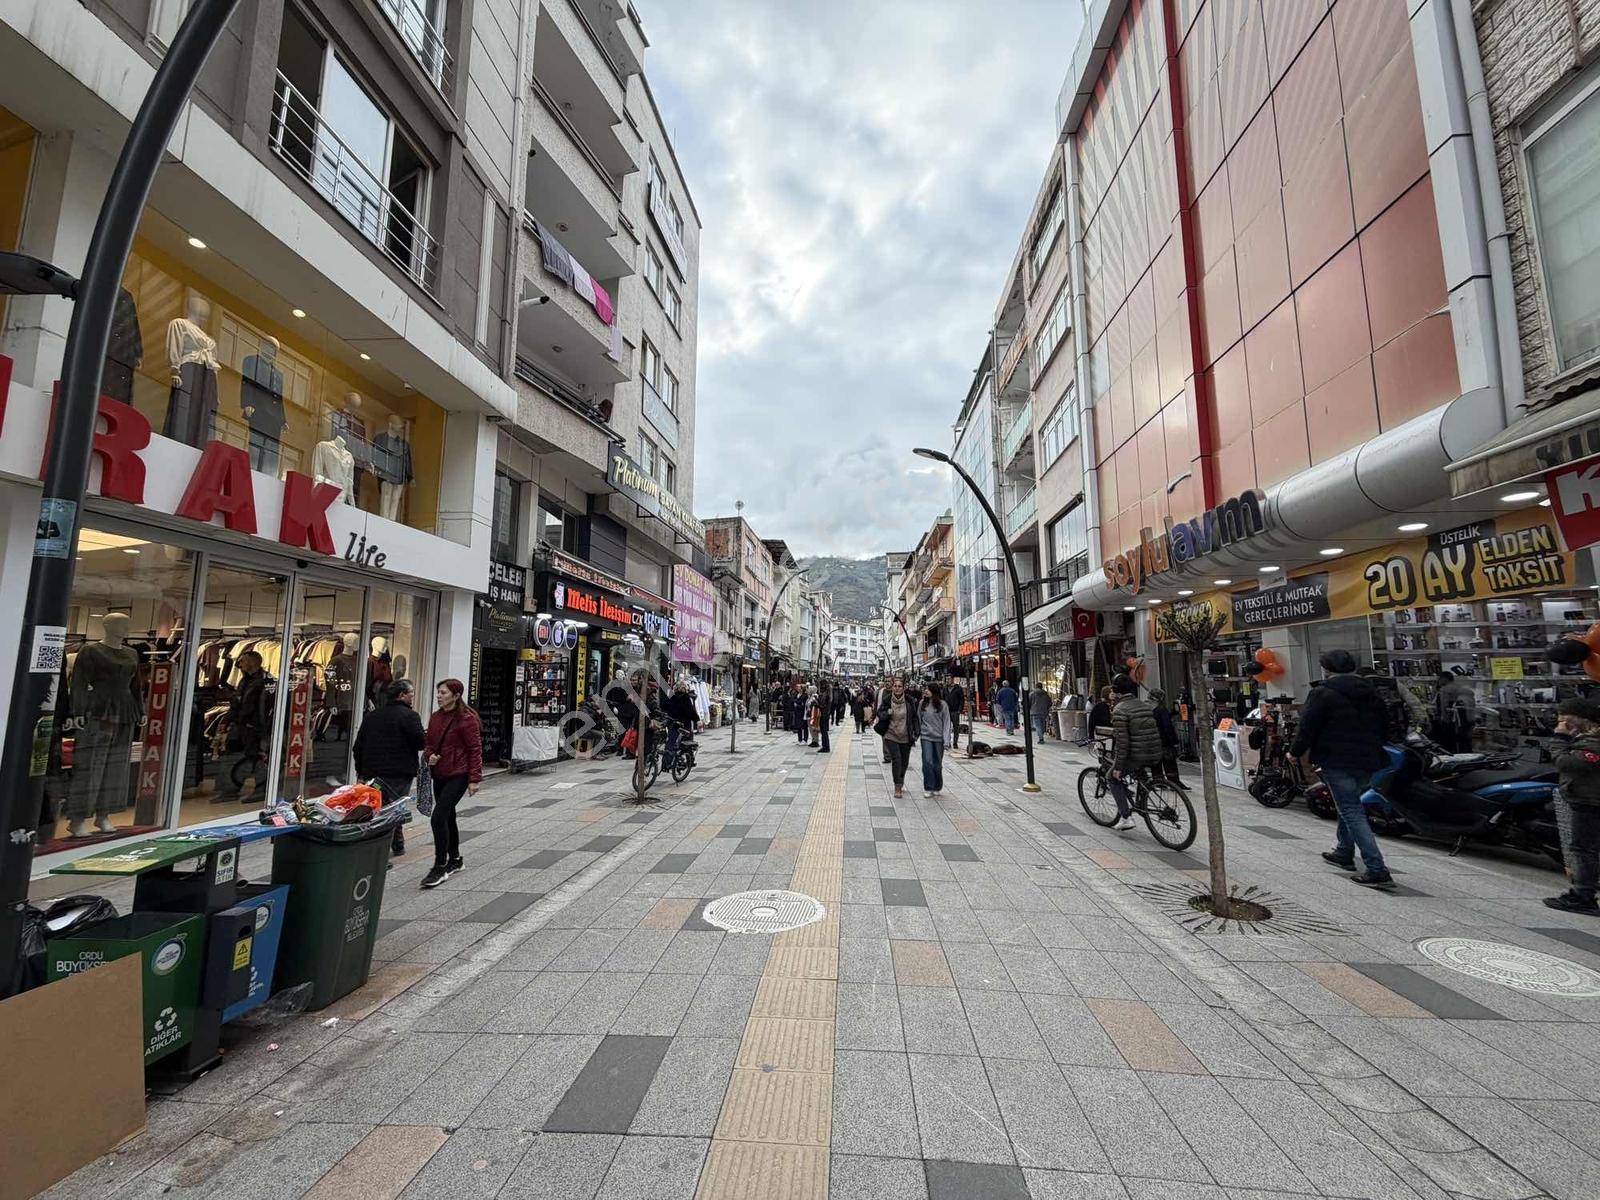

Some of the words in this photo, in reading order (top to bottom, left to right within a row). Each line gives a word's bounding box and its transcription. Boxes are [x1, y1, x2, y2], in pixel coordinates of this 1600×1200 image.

[613, 456, 658, 498] Platinum
[344, 532, 387, 569] life
[1103, 527, 1170, 596] soylu
[1171, 489, 1266, 564] avm
[1440, 525, 1481, 546] ÜSTELİK
[1480, 525, 1551, 562] ELDEN
[1366, 558, 1410, 604] 20
[1423, 543, 1467, 597] AY
[1485, 555, 1561, 590] TAKSİT
[567, 588, 598, 615] Melis
[1235, 600, 1244, 612] EV
[1244, 592, 1275, 610] TEKSTİLİ
[1276, 592, 1283, 602] &
[1285, 584, 1323, 601] MUTFAK
[1244, 601, 1316, 626] GEREÇLERİNDE
[142, 668, 169, 788] BURAK
[289, 669, 309, 768] BURAK
[79, 951, 103, 960] ORDU
[144, 1032, 182, 1057] ATIKLAR
